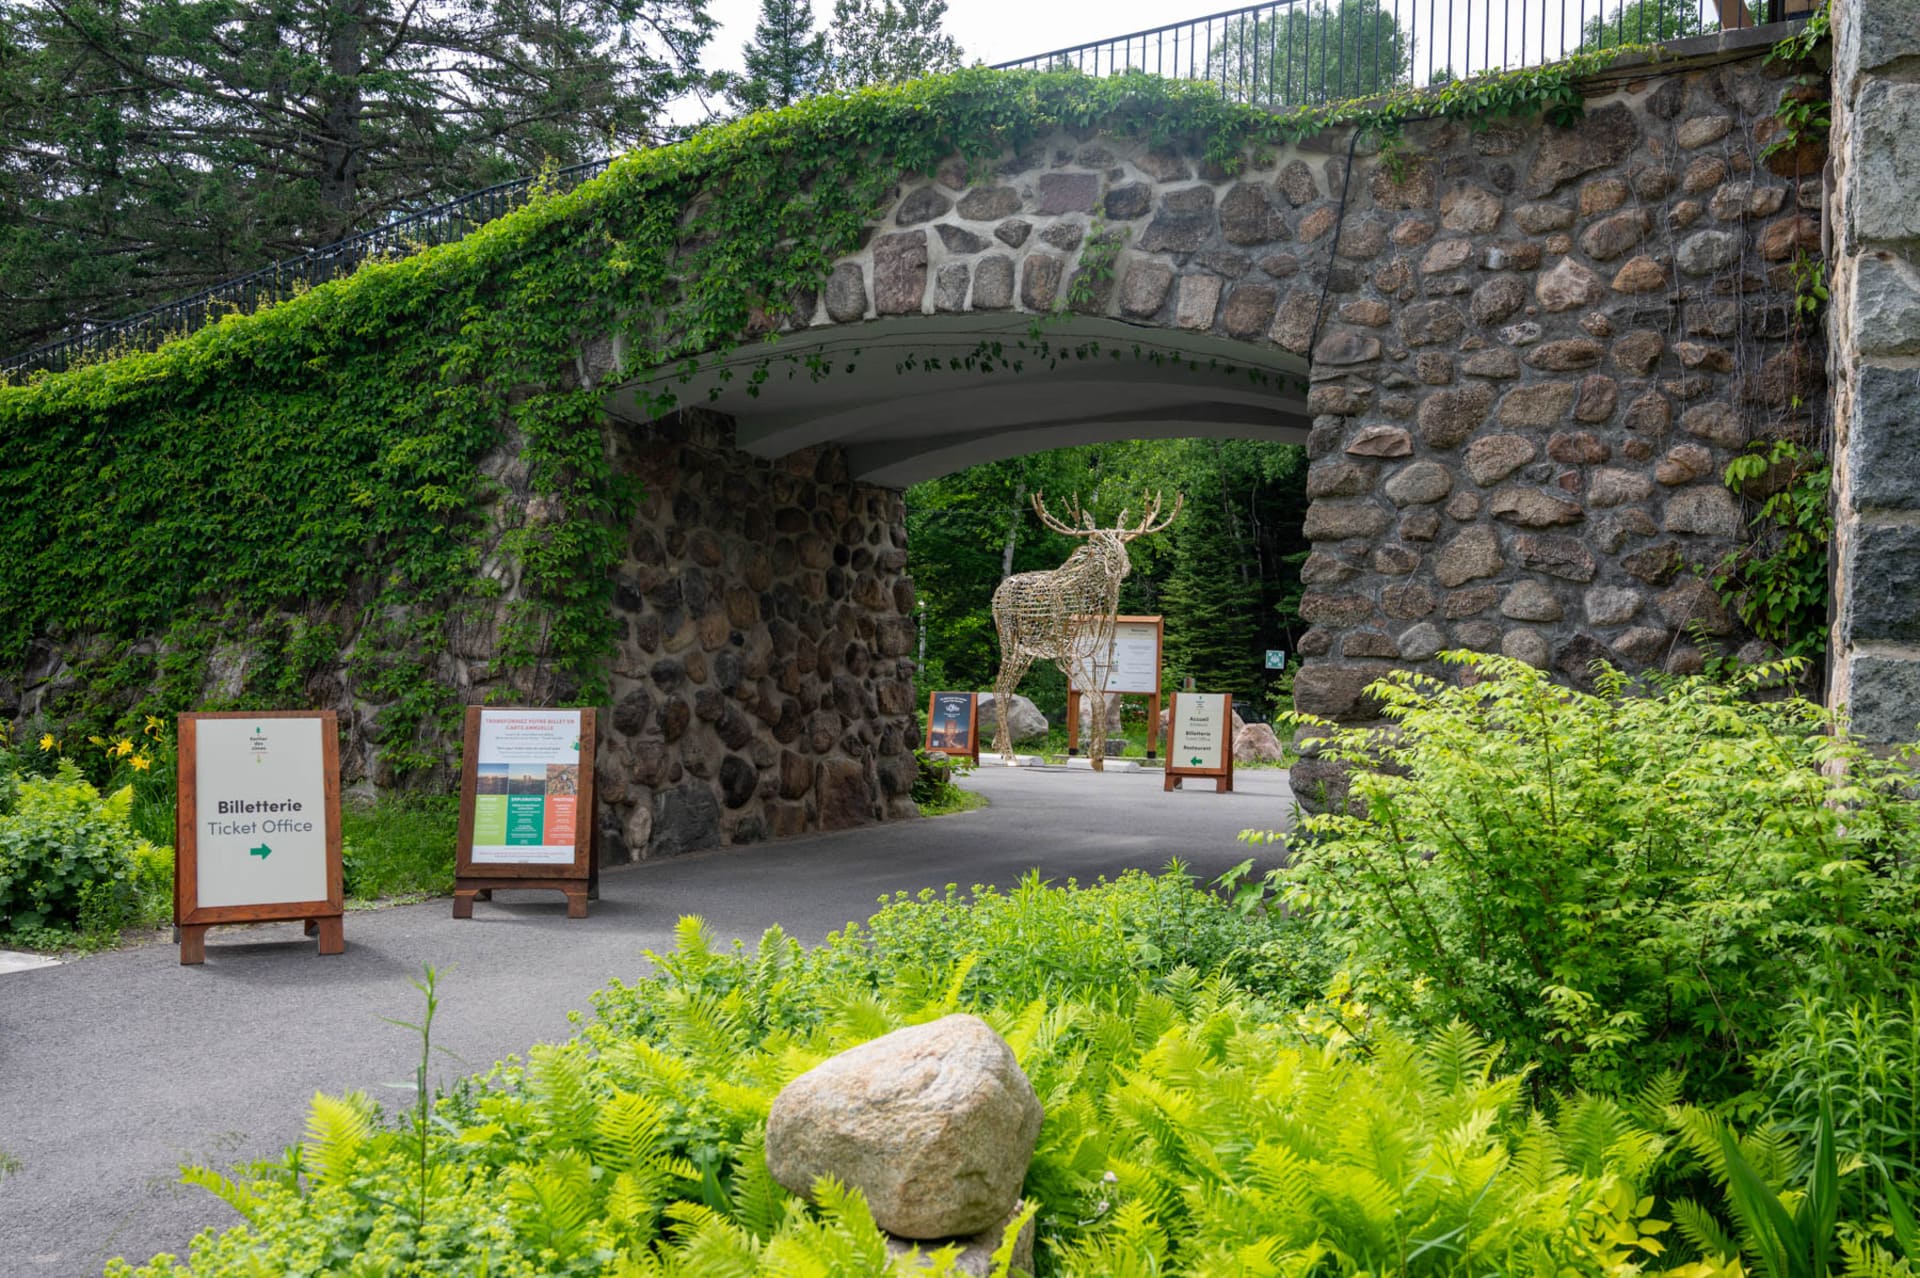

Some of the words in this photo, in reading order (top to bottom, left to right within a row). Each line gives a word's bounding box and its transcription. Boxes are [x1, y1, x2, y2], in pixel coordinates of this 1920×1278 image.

[218, 799, 303, 814] Billetterie
[208, 821, 257, 836] Ticket
[262, 819, 313, 834] Office
